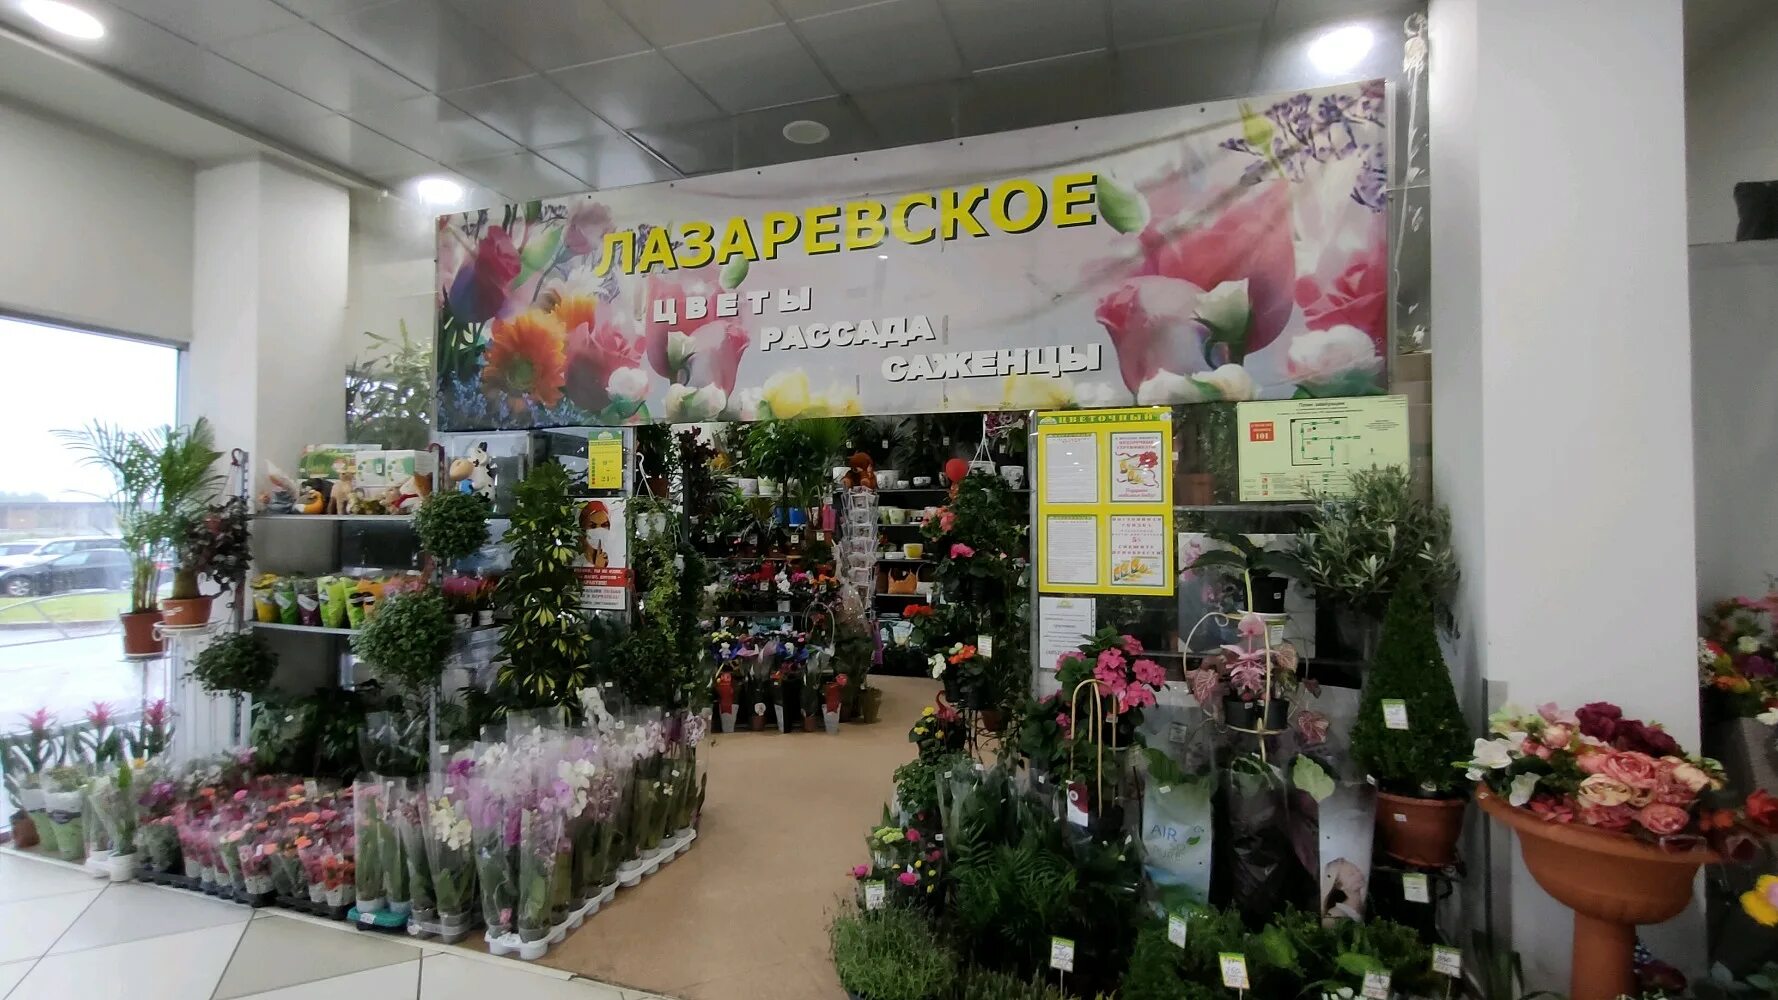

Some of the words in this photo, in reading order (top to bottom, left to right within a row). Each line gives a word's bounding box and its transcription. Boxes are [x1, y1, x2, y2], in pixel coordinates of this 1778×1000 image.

[594, 172, 1097, 278] ЛАЗАРЕВСКОЕ
[653, 286, 812, 325] ЦВЕТЫ
[760, 314, 936, 351] РАССАДА
[881, 343, 1102, 382] САЖЕНЦЫ
[1058, 412, 1153, 424] ЦВЕТОЧНЫЙ
[1255, 432, 1269, 440] 101
[1150, 824, 1177, 842] AIR
